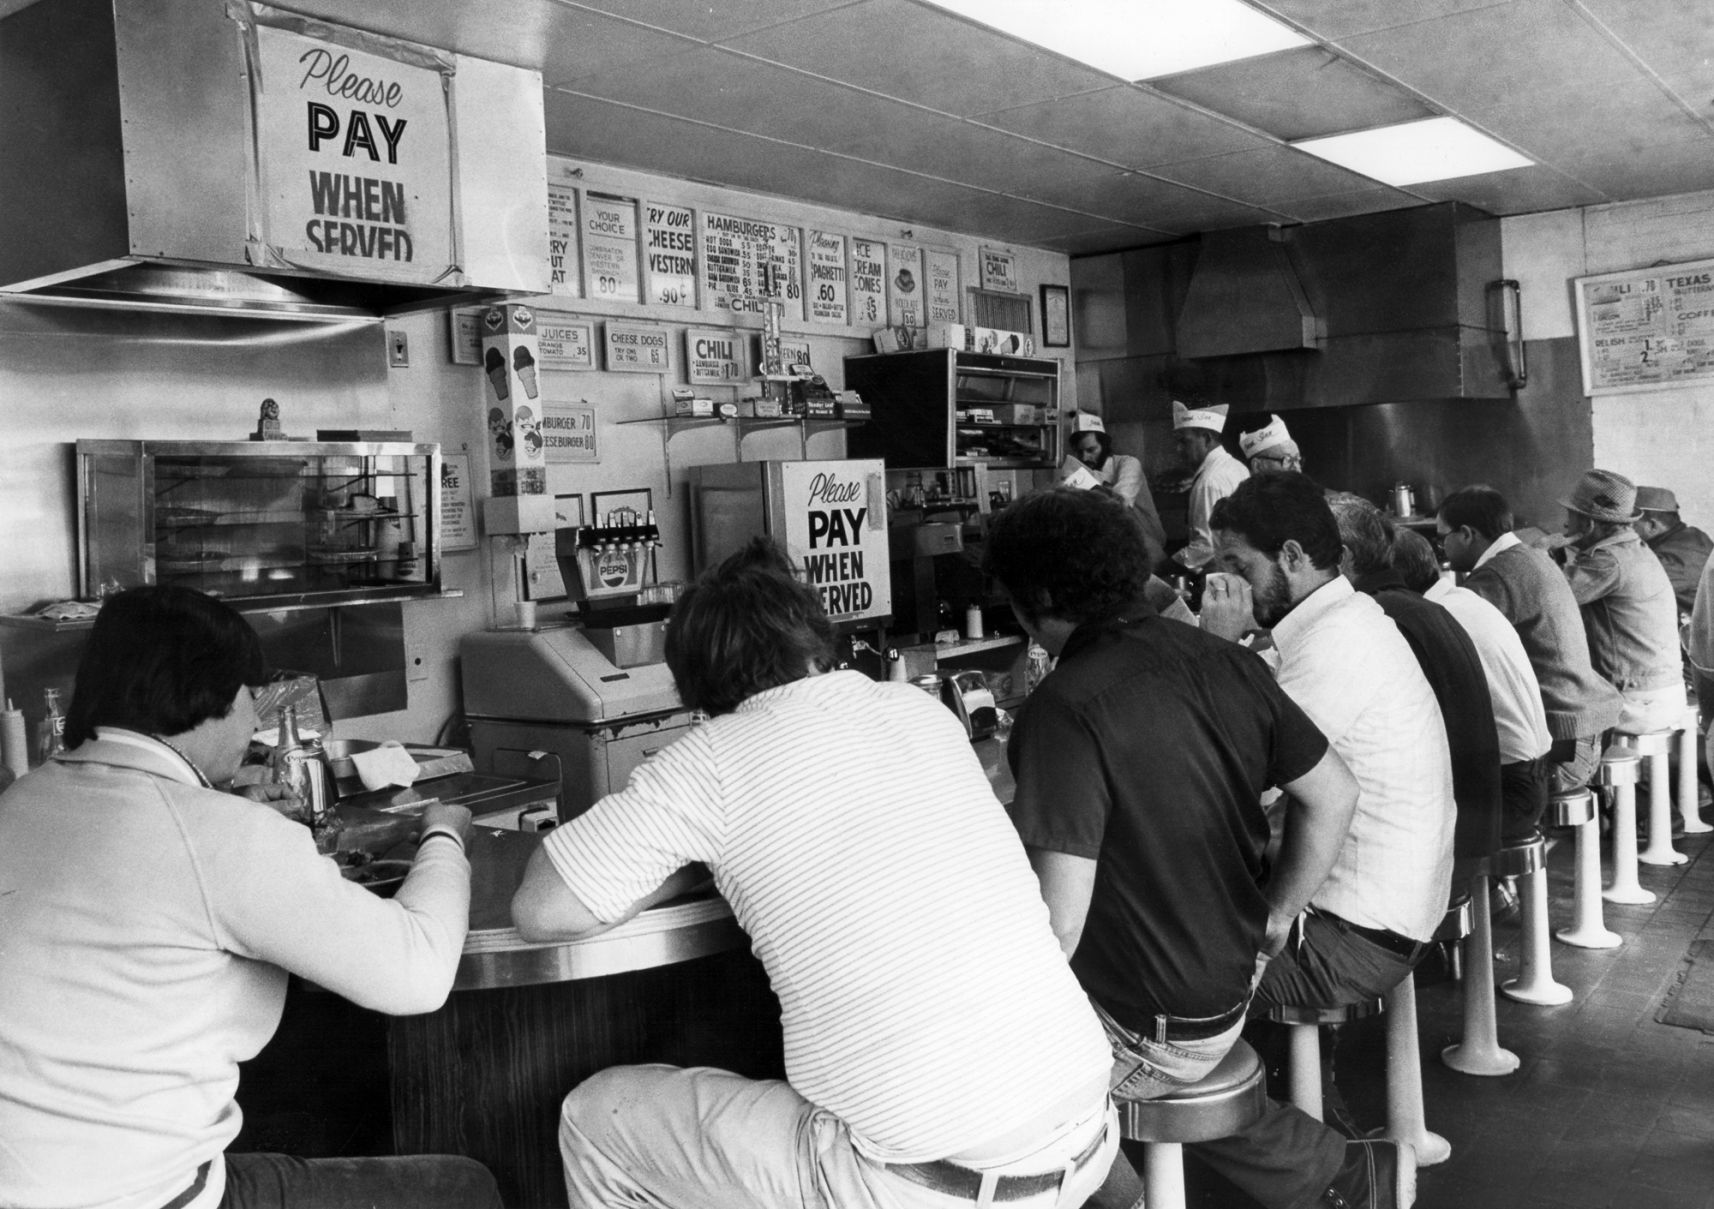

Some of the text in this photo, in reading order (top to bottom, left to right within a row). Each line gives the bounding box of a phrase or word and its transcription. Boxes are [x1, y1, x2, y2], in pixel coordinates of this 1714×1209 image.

[299, 48, 404, 109] Please
[307, 101, 408, 165] PAY
[308, 169, 406, 225] WHEN
[597, 210, 620, 223] YOUR
[647, 207, 690, 228] RY OUR
[589, 219, 625, 235] CHOICE
[707, 215, 776, 240] HAMBURGERS
[550, 240, 568, 255] RY
[856, 242, 871, 259] ICE
[934, 278, 949, 290] PAY
[1666, 273, 1711, 289] TEXAS
[786, 283, 799, 299] 80
[731, 298, 765, 313] CHIL
[931, 306, 956, 321] SERVED
[541, 328, 579, 341] JUICES
[610, 333, 664, 346] CHEESE DOGS
[539, 348, 563, 356] TOMATO
[696, 339, 733, 360] CHILI
[441, 477, 460, 489] REE
[808, 472, 861, 507] Please
[808, 508, 867, 550] PAY
[600, 564, 628, 577] PEPSI
[803, 550, 864, 584] WHEN
[820, 581, 873, 615] ERVED
